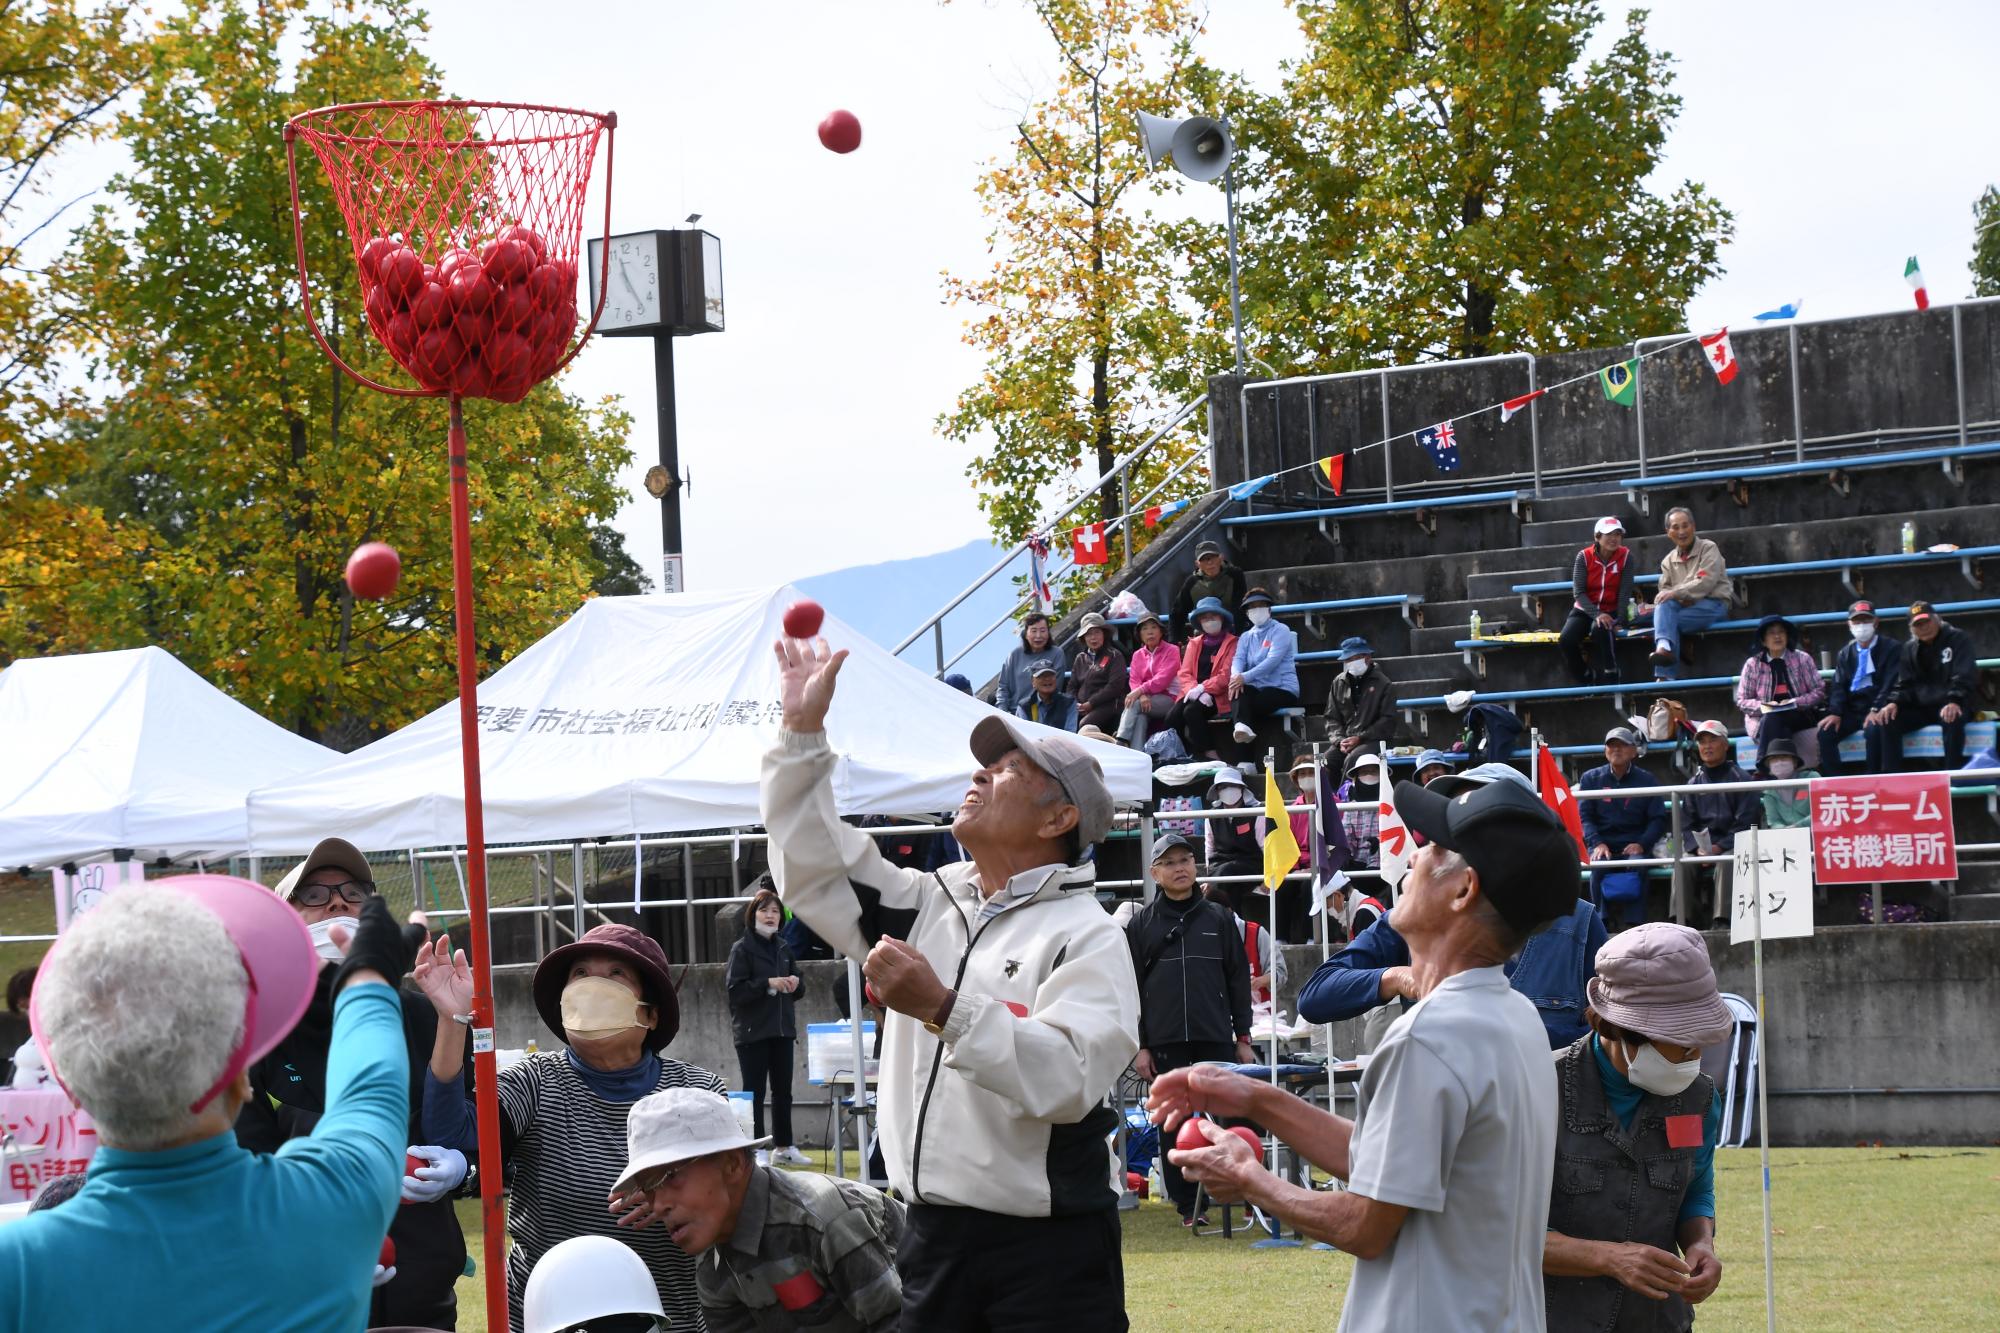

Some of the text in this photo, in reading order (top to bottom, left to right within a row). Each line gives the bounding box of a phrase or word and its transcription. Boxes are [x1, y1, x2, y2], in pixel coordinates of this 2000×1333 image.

[620, 242, 630, 254] 12
[635, 246, 640, 256] 1
[644, 255, 651, 267] 2
[648, 273, 655, 285] 3
[646, 291, 652, 302] 4
[615, 308, 620, 319] 7
[625, 310, 632, 322] 6
[1819, 791, 1943, 827] 赤チーム
[1821, 832, 1946, 870] 待機場所
